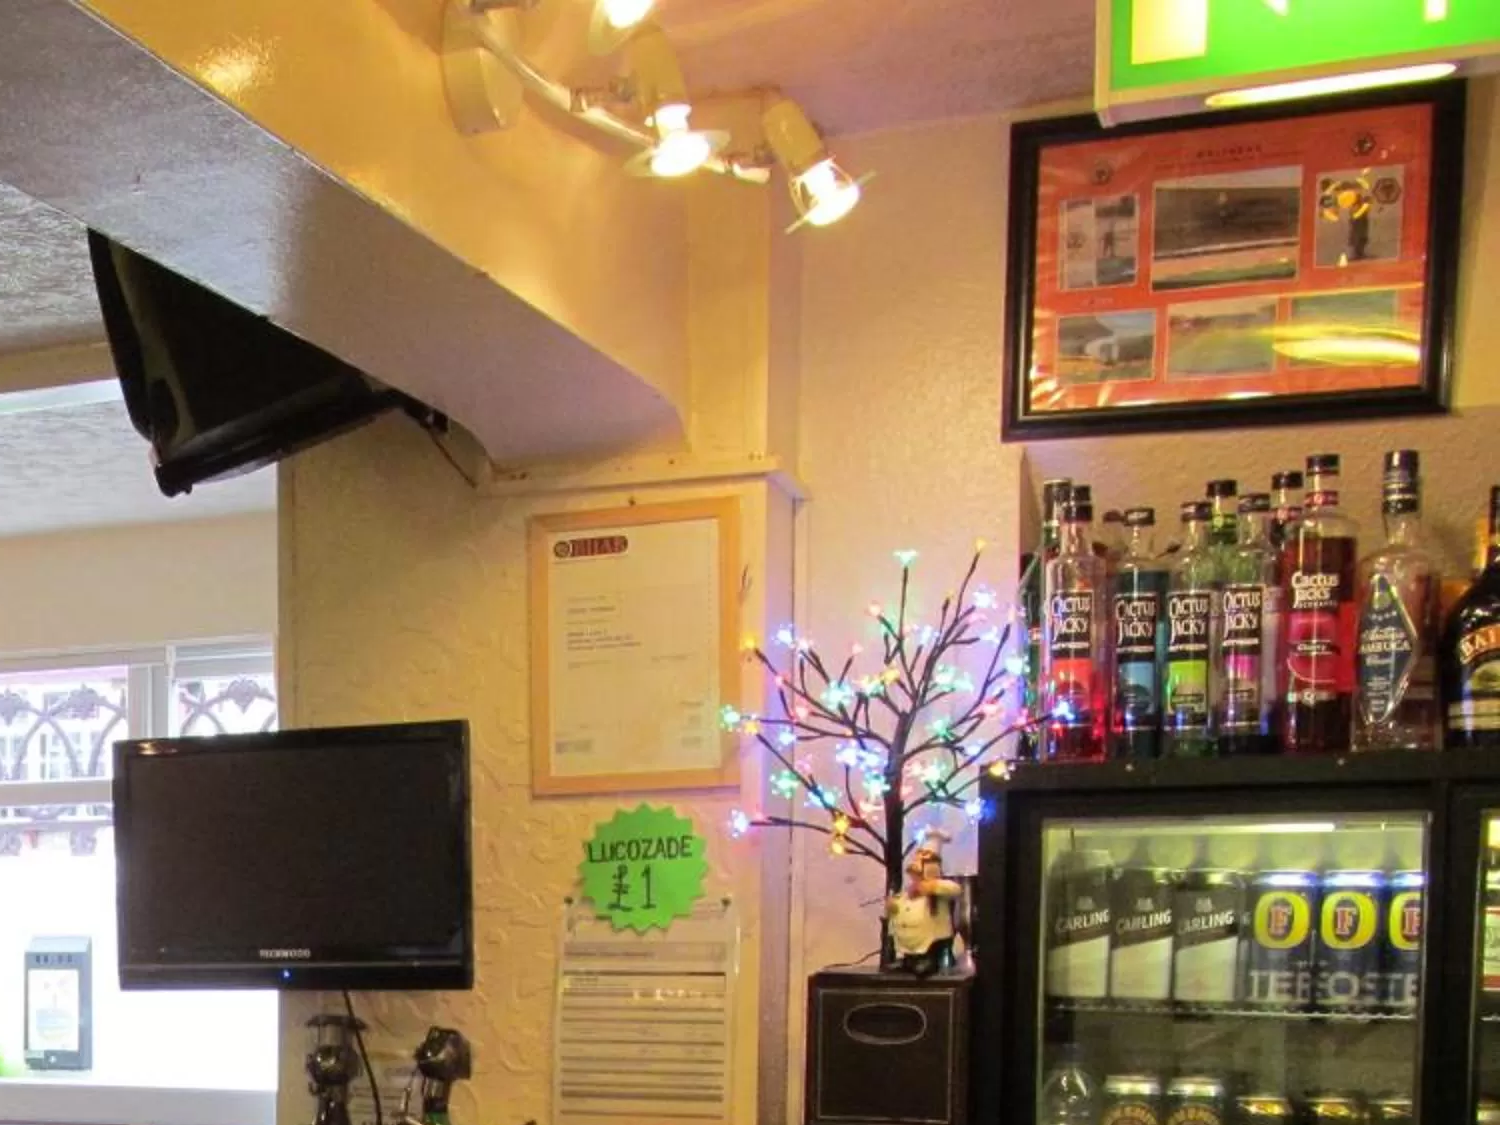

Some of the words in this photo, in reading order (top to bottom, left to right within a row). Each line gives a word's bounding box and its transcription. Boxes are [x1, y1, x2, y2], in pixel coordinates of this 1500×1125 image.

[587, 835, 693, 863] LUCOZADE
[1055, 908, 1111, 934] CARLING
[1115, 908, 1173, 934] CARLING
[1178, 909, 1236, 934] CARLING
